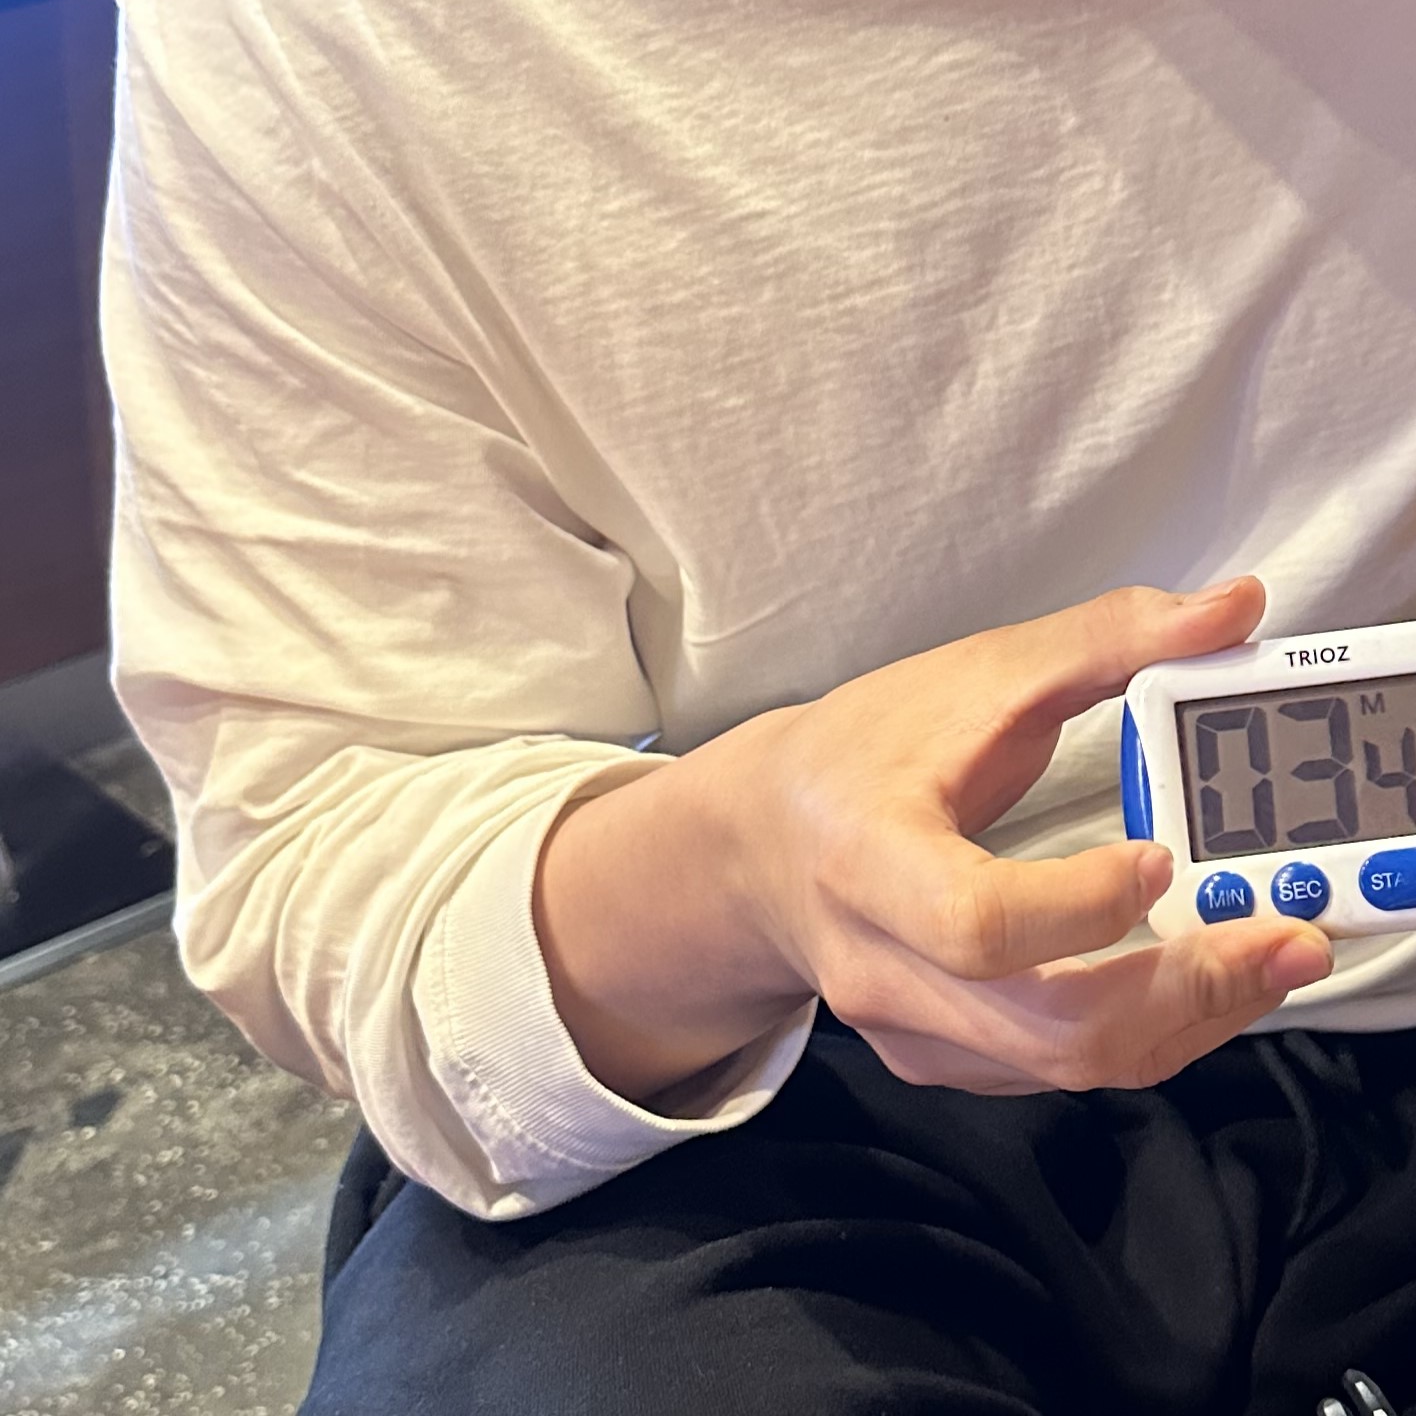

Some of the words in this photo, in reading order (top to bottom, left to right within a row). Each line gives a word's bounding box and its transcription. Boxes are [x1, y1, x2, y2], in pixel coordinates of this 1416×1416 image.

[1285, 645, 1351, 668] TRIOZ
[1209, 887, 1246, 910] MIN
[1278, 880, 1323, 902] SEC
